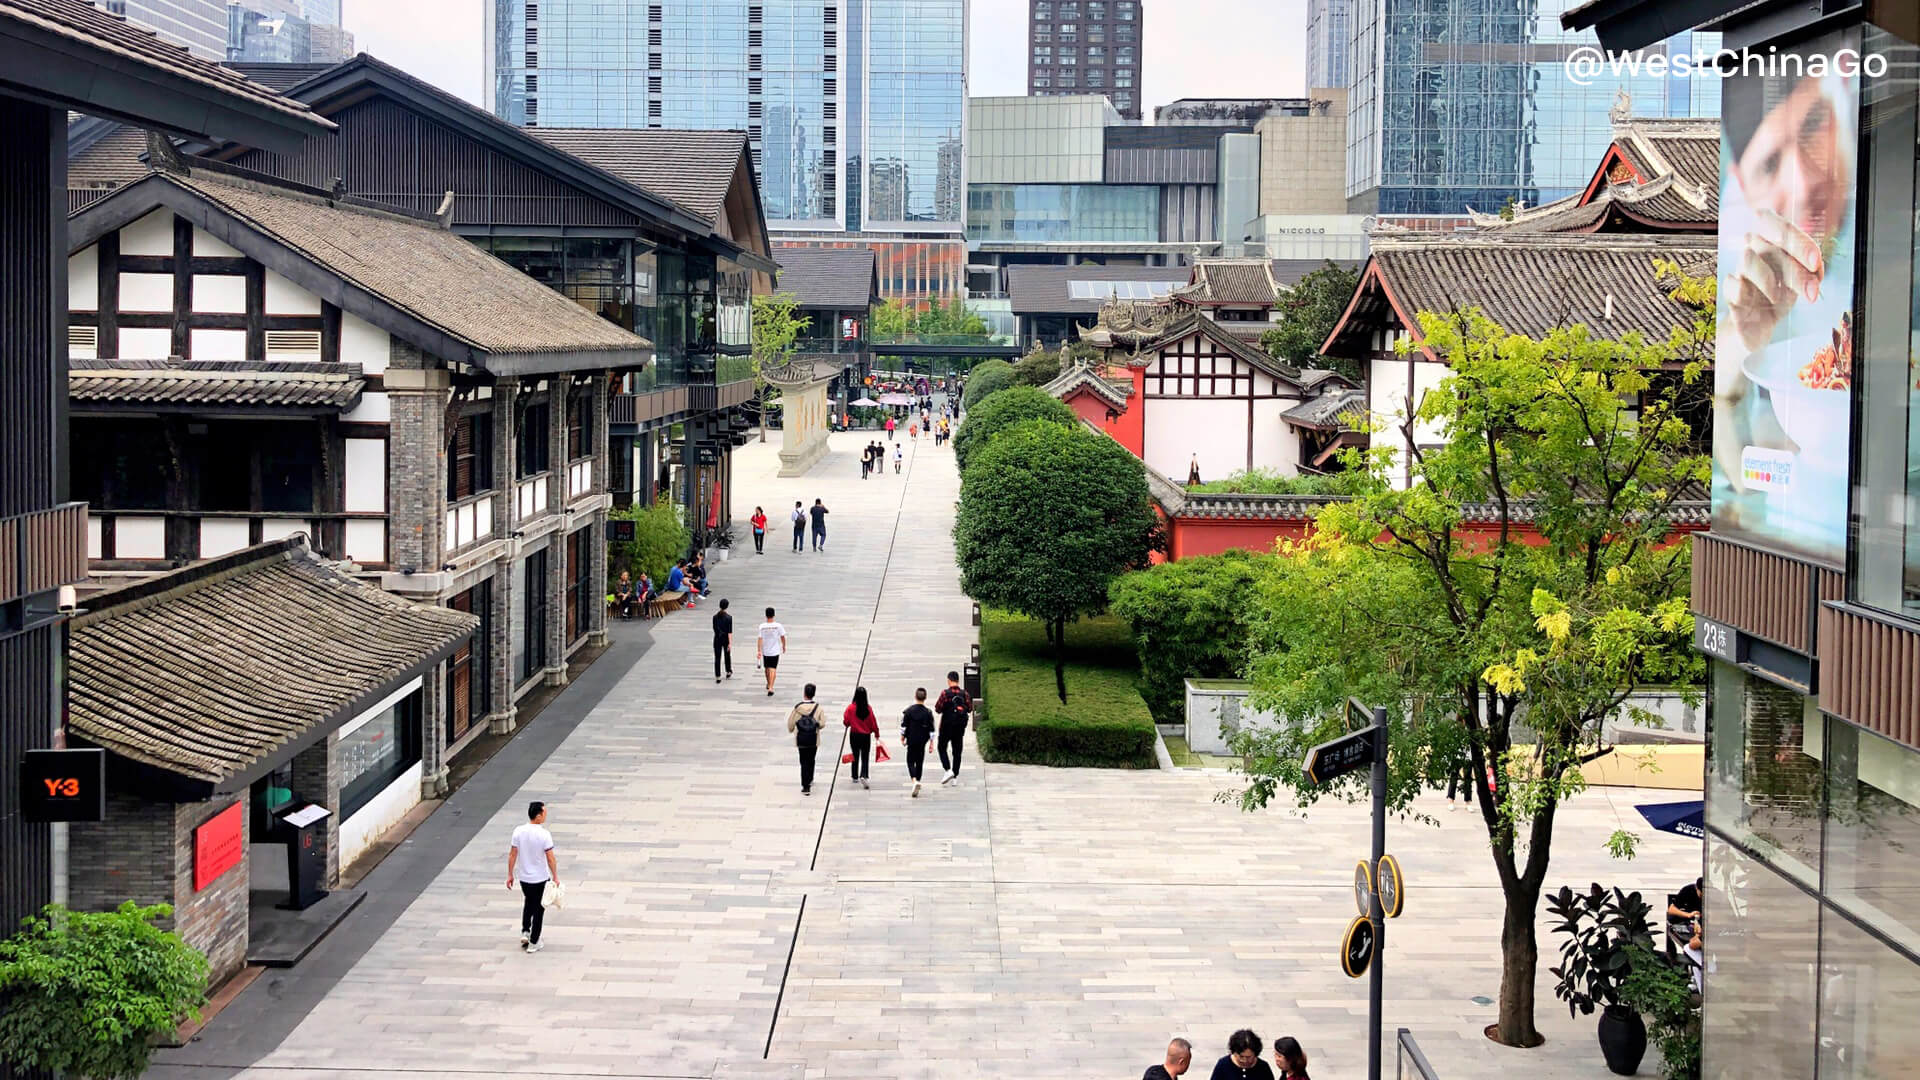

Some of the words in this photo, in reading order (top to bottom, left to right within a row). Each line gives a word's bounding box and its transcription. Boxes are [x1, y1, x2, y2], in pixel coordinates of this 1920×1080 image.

[1279, 227, 1326, 235] NICCOLO
[1744, 457, 1772, 472] element
[44, 778, 80, 797] Y-3
